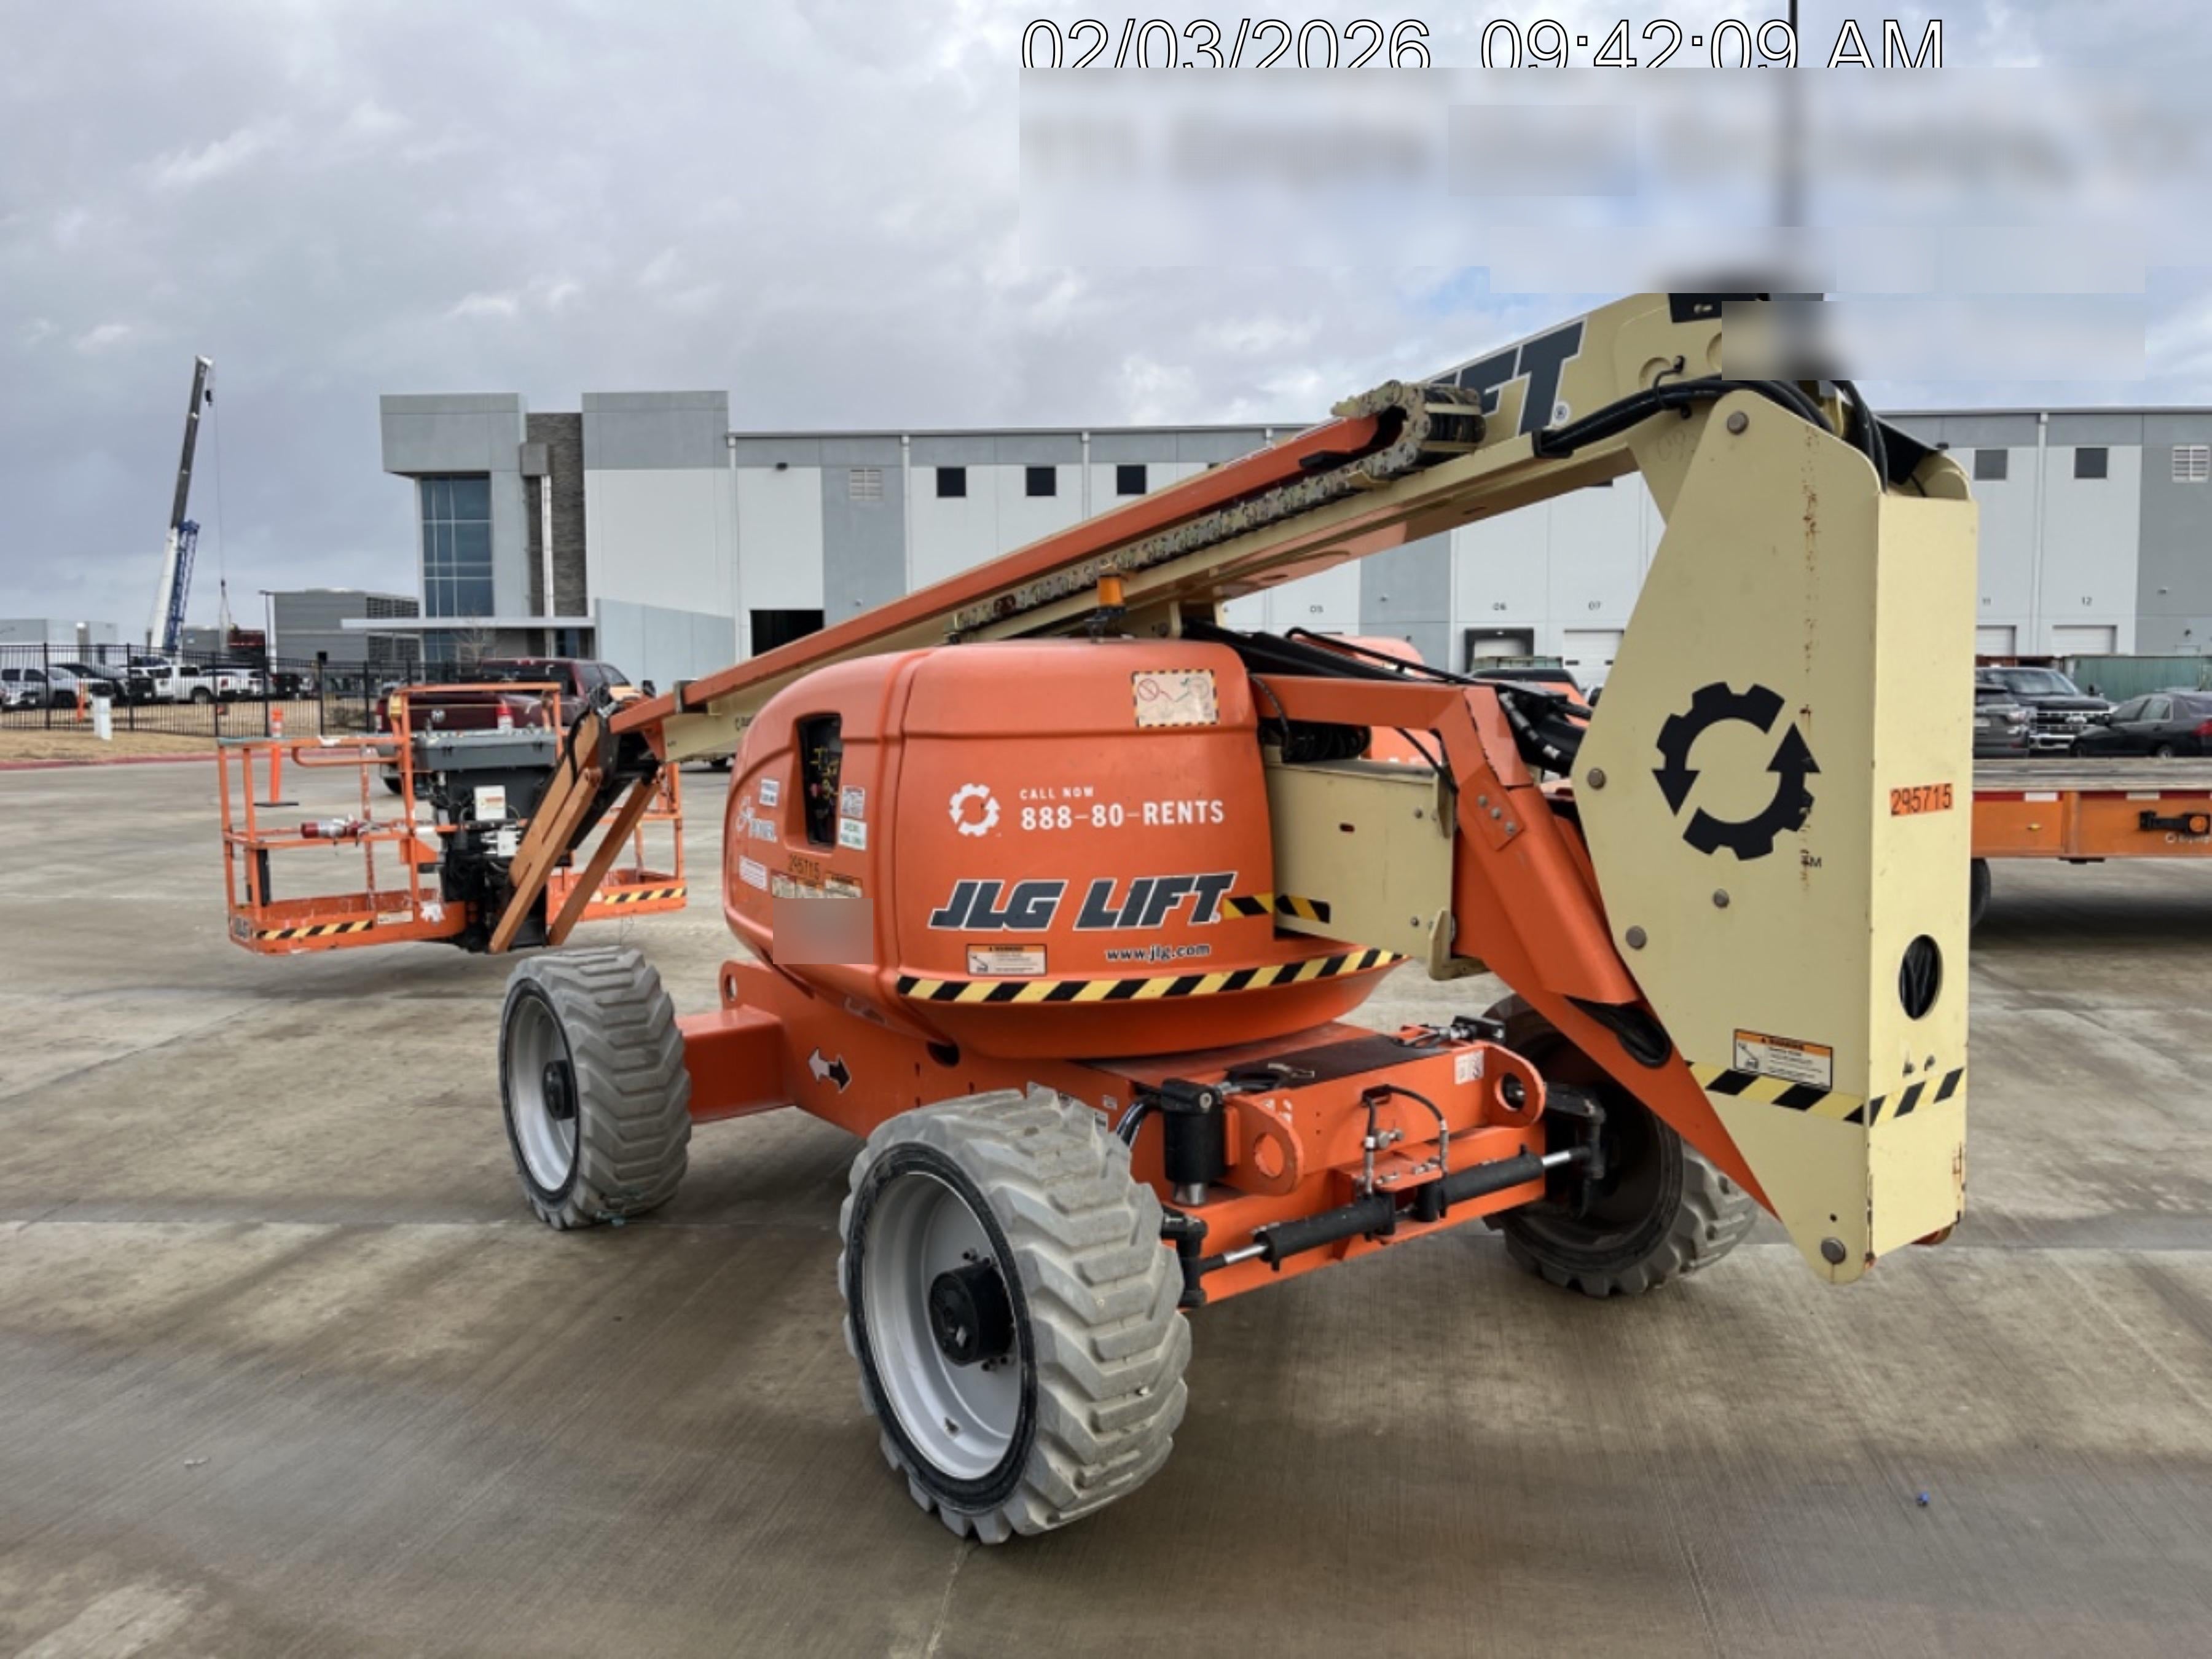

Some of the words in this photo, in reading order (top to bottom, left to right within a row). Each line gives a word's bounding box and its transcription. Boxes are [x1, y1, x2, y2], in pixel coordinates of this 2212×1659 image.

[2082, 596, 2093, 606] 12
[1019, 788, 1056, 799] CALL
[1062, 786, 1094, 798] NOW
[1891, 783, 1951, 815] 295715
[1021, 800, 1225, 830] 888-80-RENTS
[927, 879, 1069, 931] JLG
[1073, 871, 1237, 931] LIFT
[1105, 943, 1211, 963] www.jlg.com
